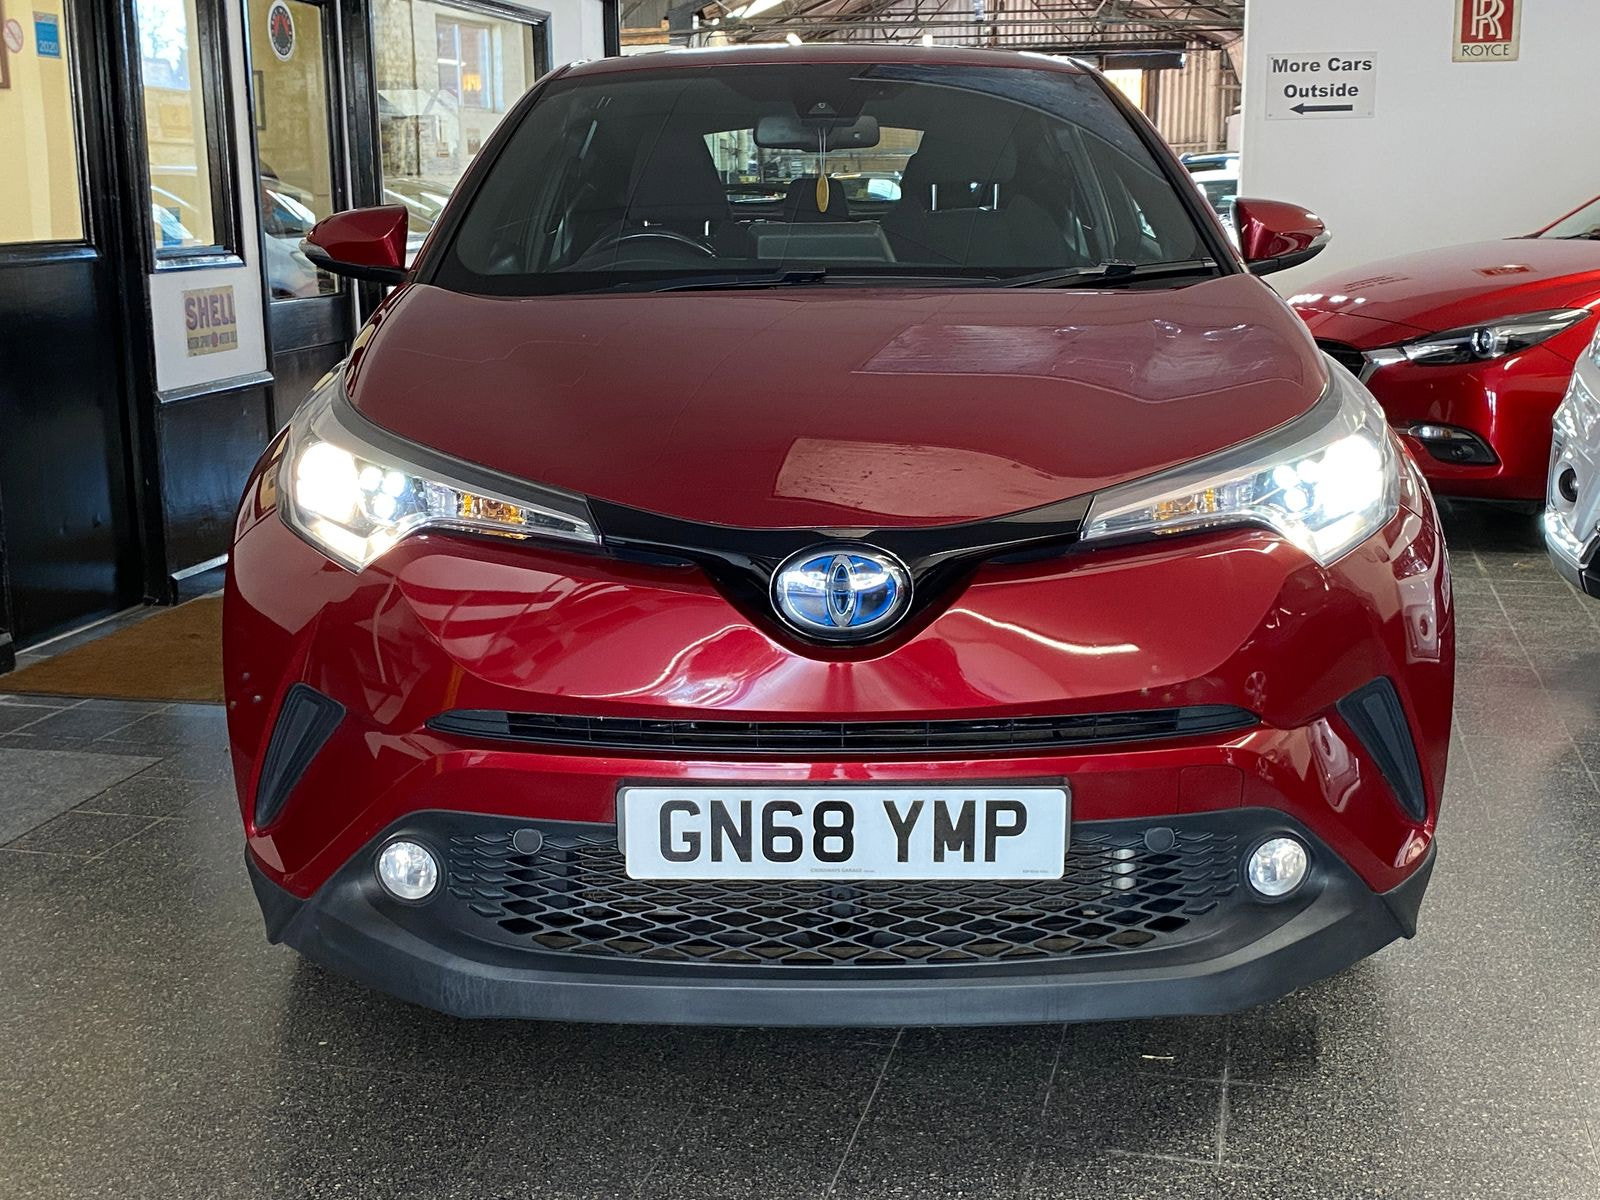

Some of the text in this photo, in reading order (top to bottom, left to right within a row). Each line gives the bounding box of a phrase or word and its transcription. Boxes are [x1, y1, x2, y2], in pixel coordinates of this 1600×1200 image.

[1461, 43, 1510, 56] ROYCE
[1272, 57, 1372, 73] More Cars
[1283, 83, 1359, 98] Outside
[185, 293, 236, 330] SHELL
[659, 800, 1028, 863] GN68 YMP
